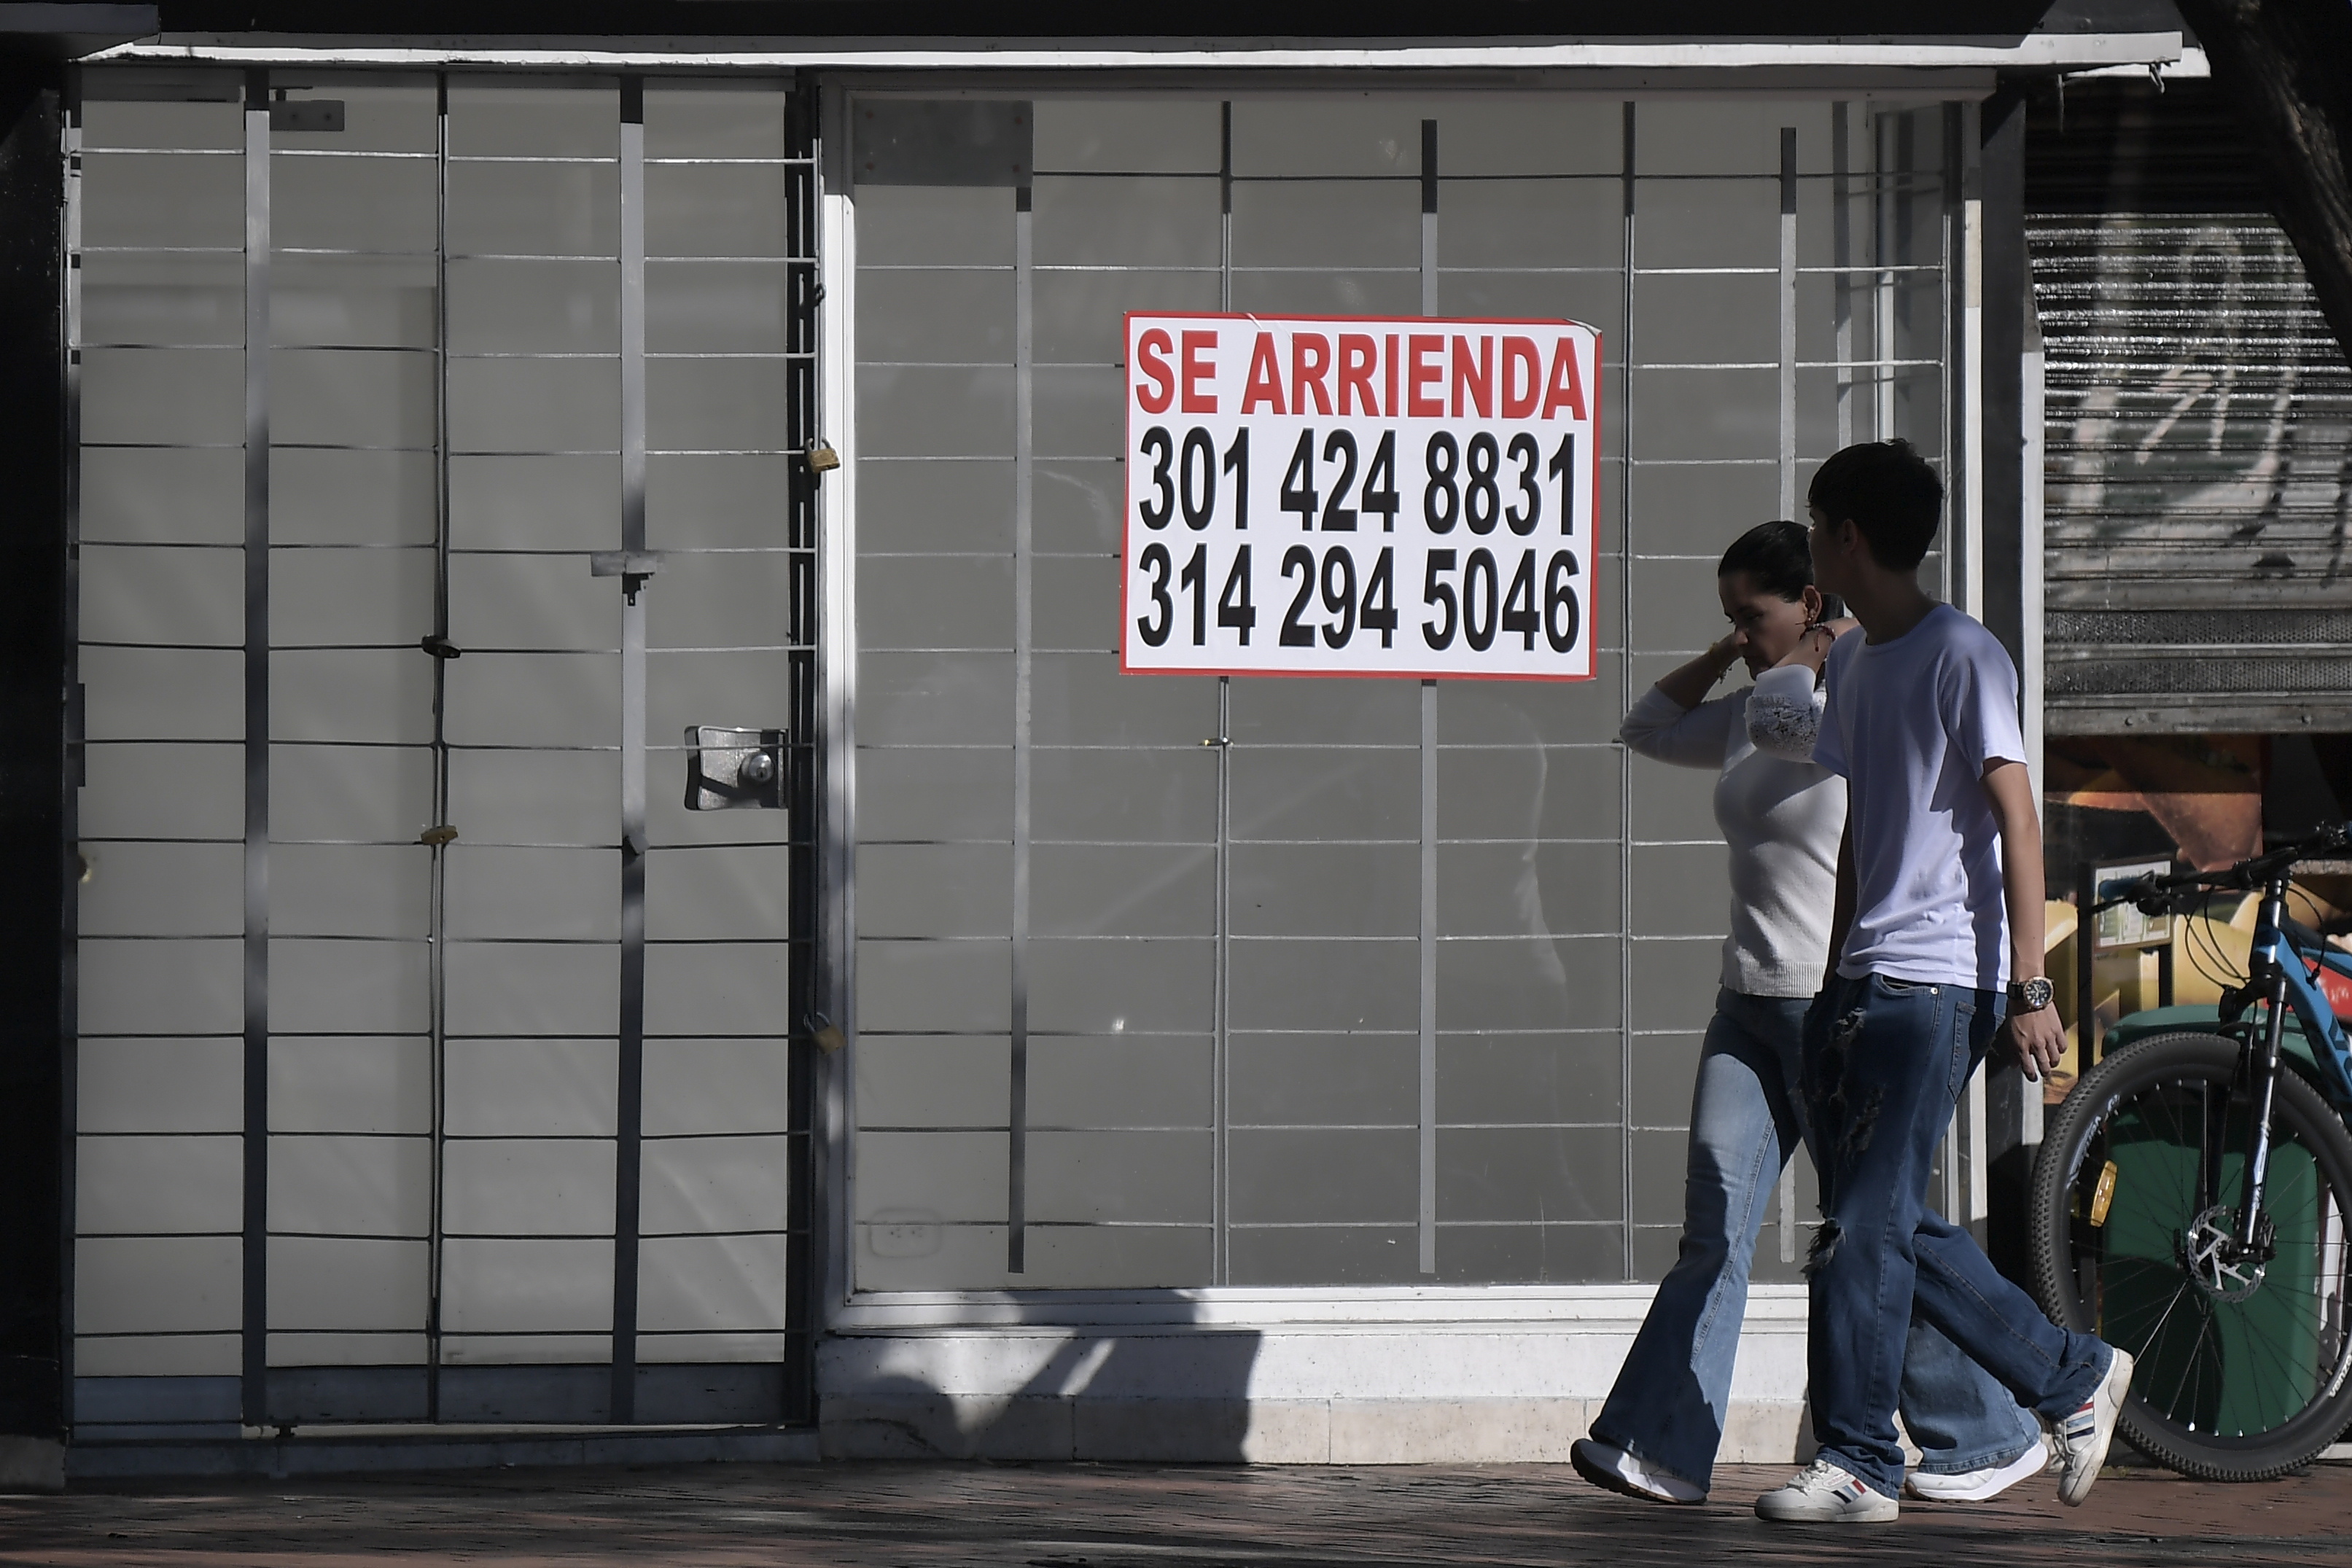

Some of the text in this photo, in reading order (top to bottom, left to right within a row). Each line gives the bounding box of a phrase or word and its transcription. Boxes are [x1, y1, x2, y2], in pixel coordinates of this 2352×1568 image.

[1136, 328, 1587, 421] SE ARRIENDA
[1139, 425, 1575, 537] 301 424 8831
[1137, 542, 1581, 653] 314 294 5046
